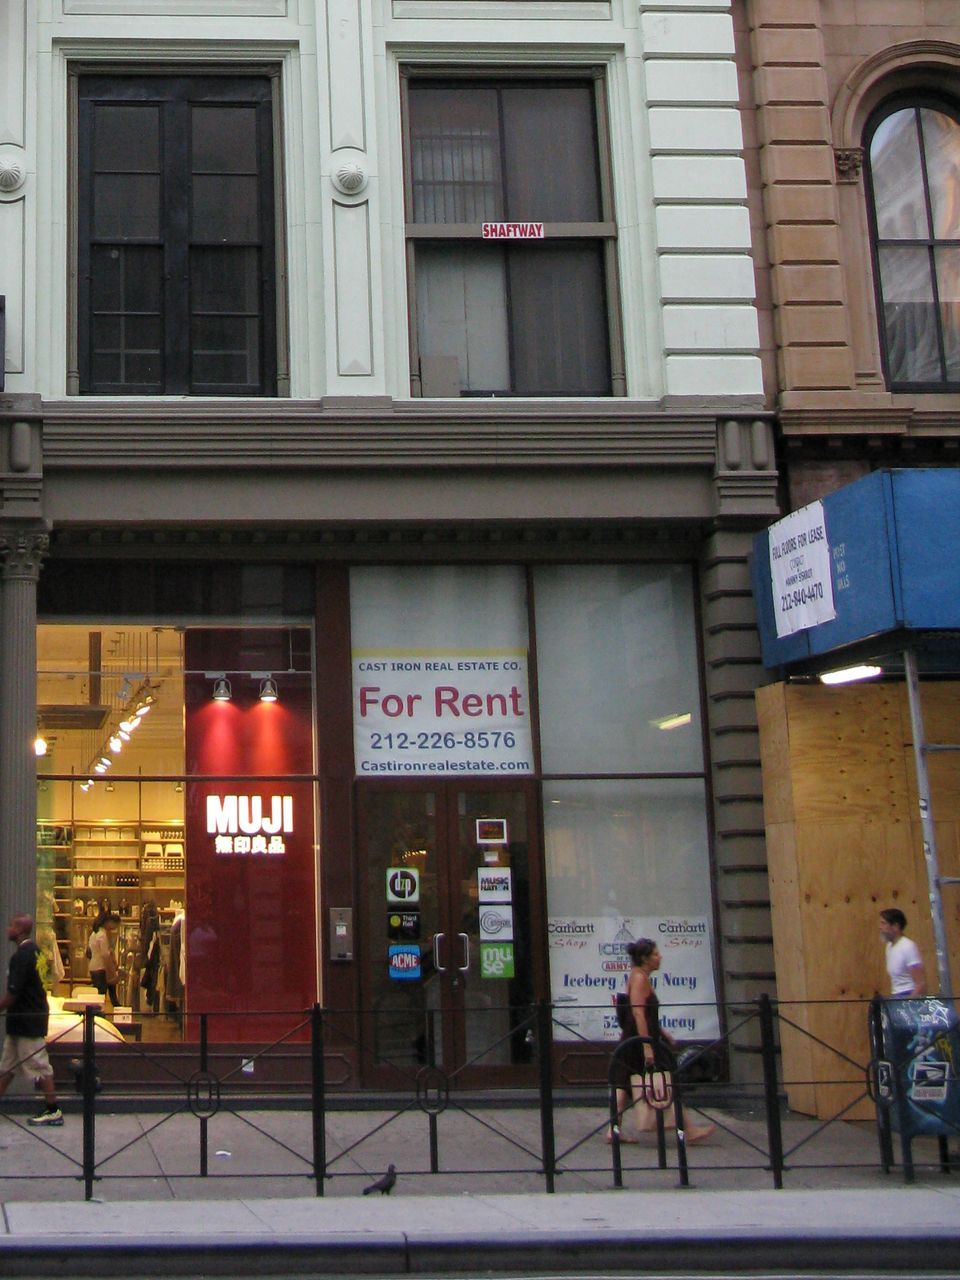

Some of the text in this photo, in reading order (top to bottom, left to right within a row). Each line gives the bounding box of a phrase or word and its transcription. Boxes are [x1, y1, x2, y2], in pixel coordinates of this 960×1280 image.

[483, 223, 543, 237] SHAFTWAY
[797, 532, 808, 549] FOR
[807, 526, 824, 544] LEASE
[781, 582, 824, 612] 212-840-4470
[358, 661, 522, 672] CAST IRON REAL ESTATE CO.
[359, 686, 525, 718] For Rent
[370, 731, 516, 750] 212-226-8576
[360, 759, 530, 772] Castironrealestate.com
[206, 795, 294, 834] MUJI
[214, 834, 286, 854] 無印良品
[547, 923, 595, 934] Carhartt
[658, 923, 707, 934] Carhartt
[392, 953, 418, 968] ACME
[563, 972, 698, 990] Iceberg Ay Navy
